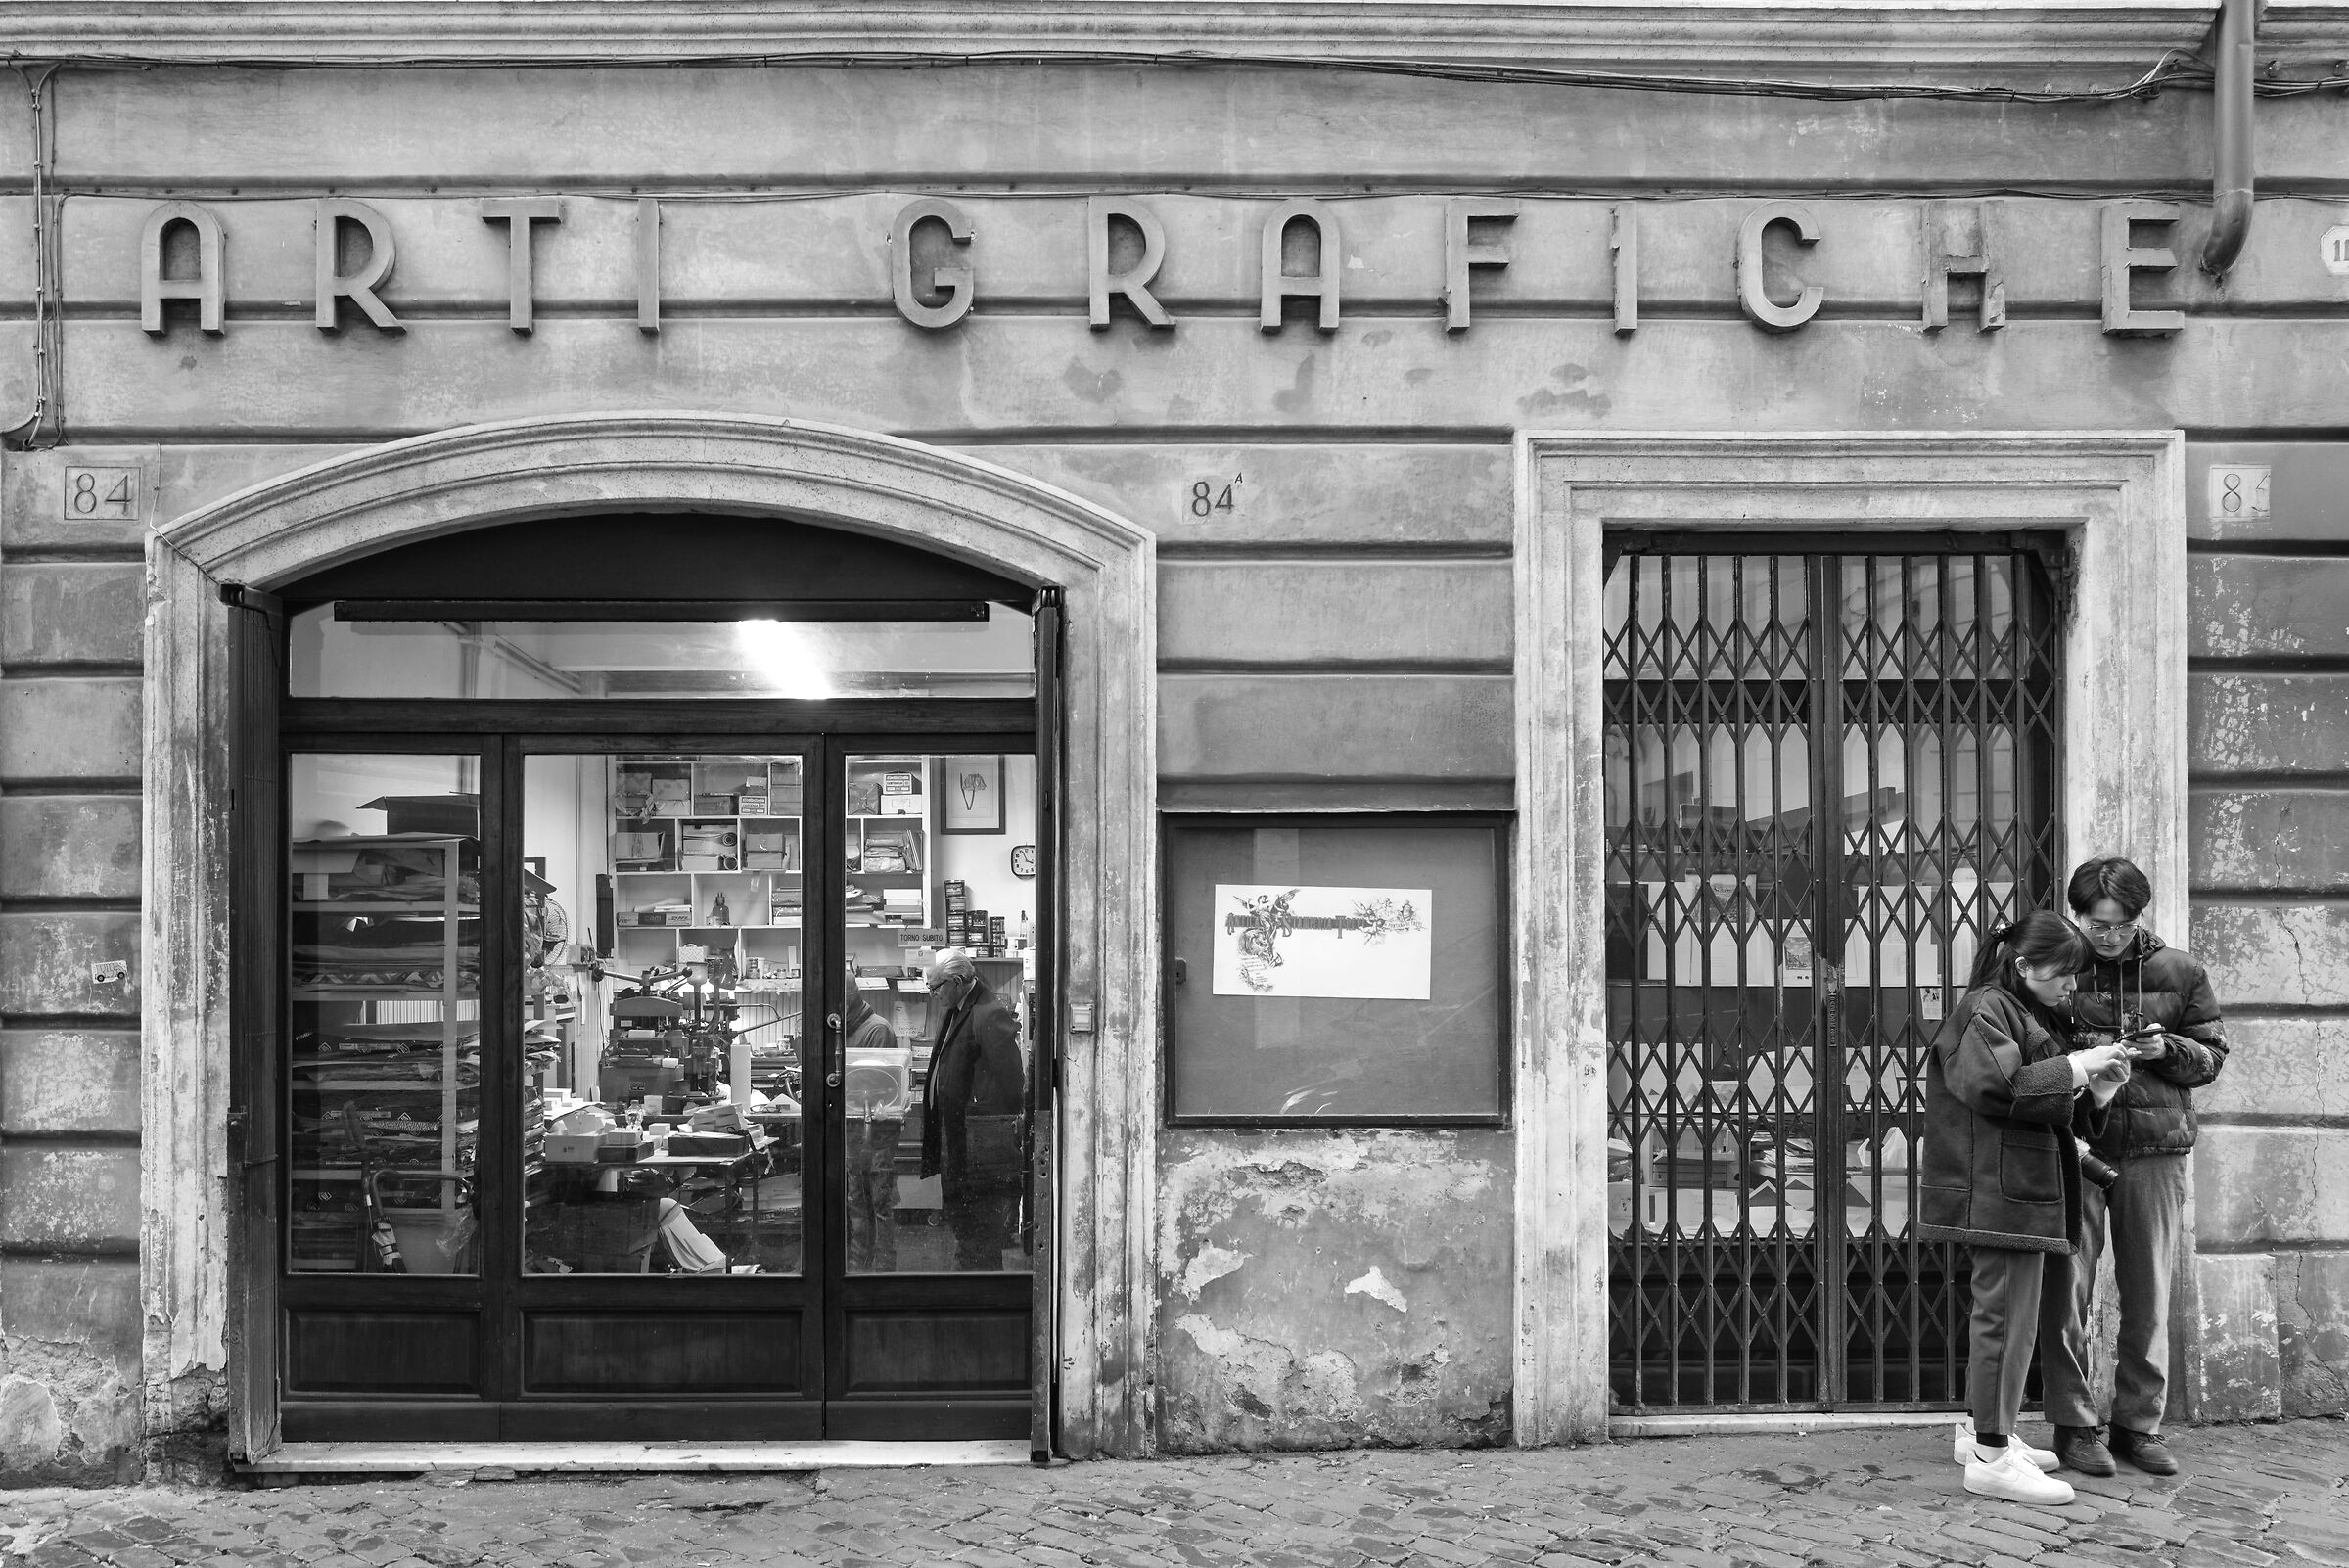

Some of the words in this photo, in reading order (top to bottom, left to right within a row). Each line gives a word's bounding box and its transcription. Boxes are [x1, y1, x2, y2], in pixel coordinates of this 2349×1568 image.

[141, 198, 660, 336] ARTI
[891, 196, 2185, 336] GRAFICHE
[74, 472, 132, 515] 84
